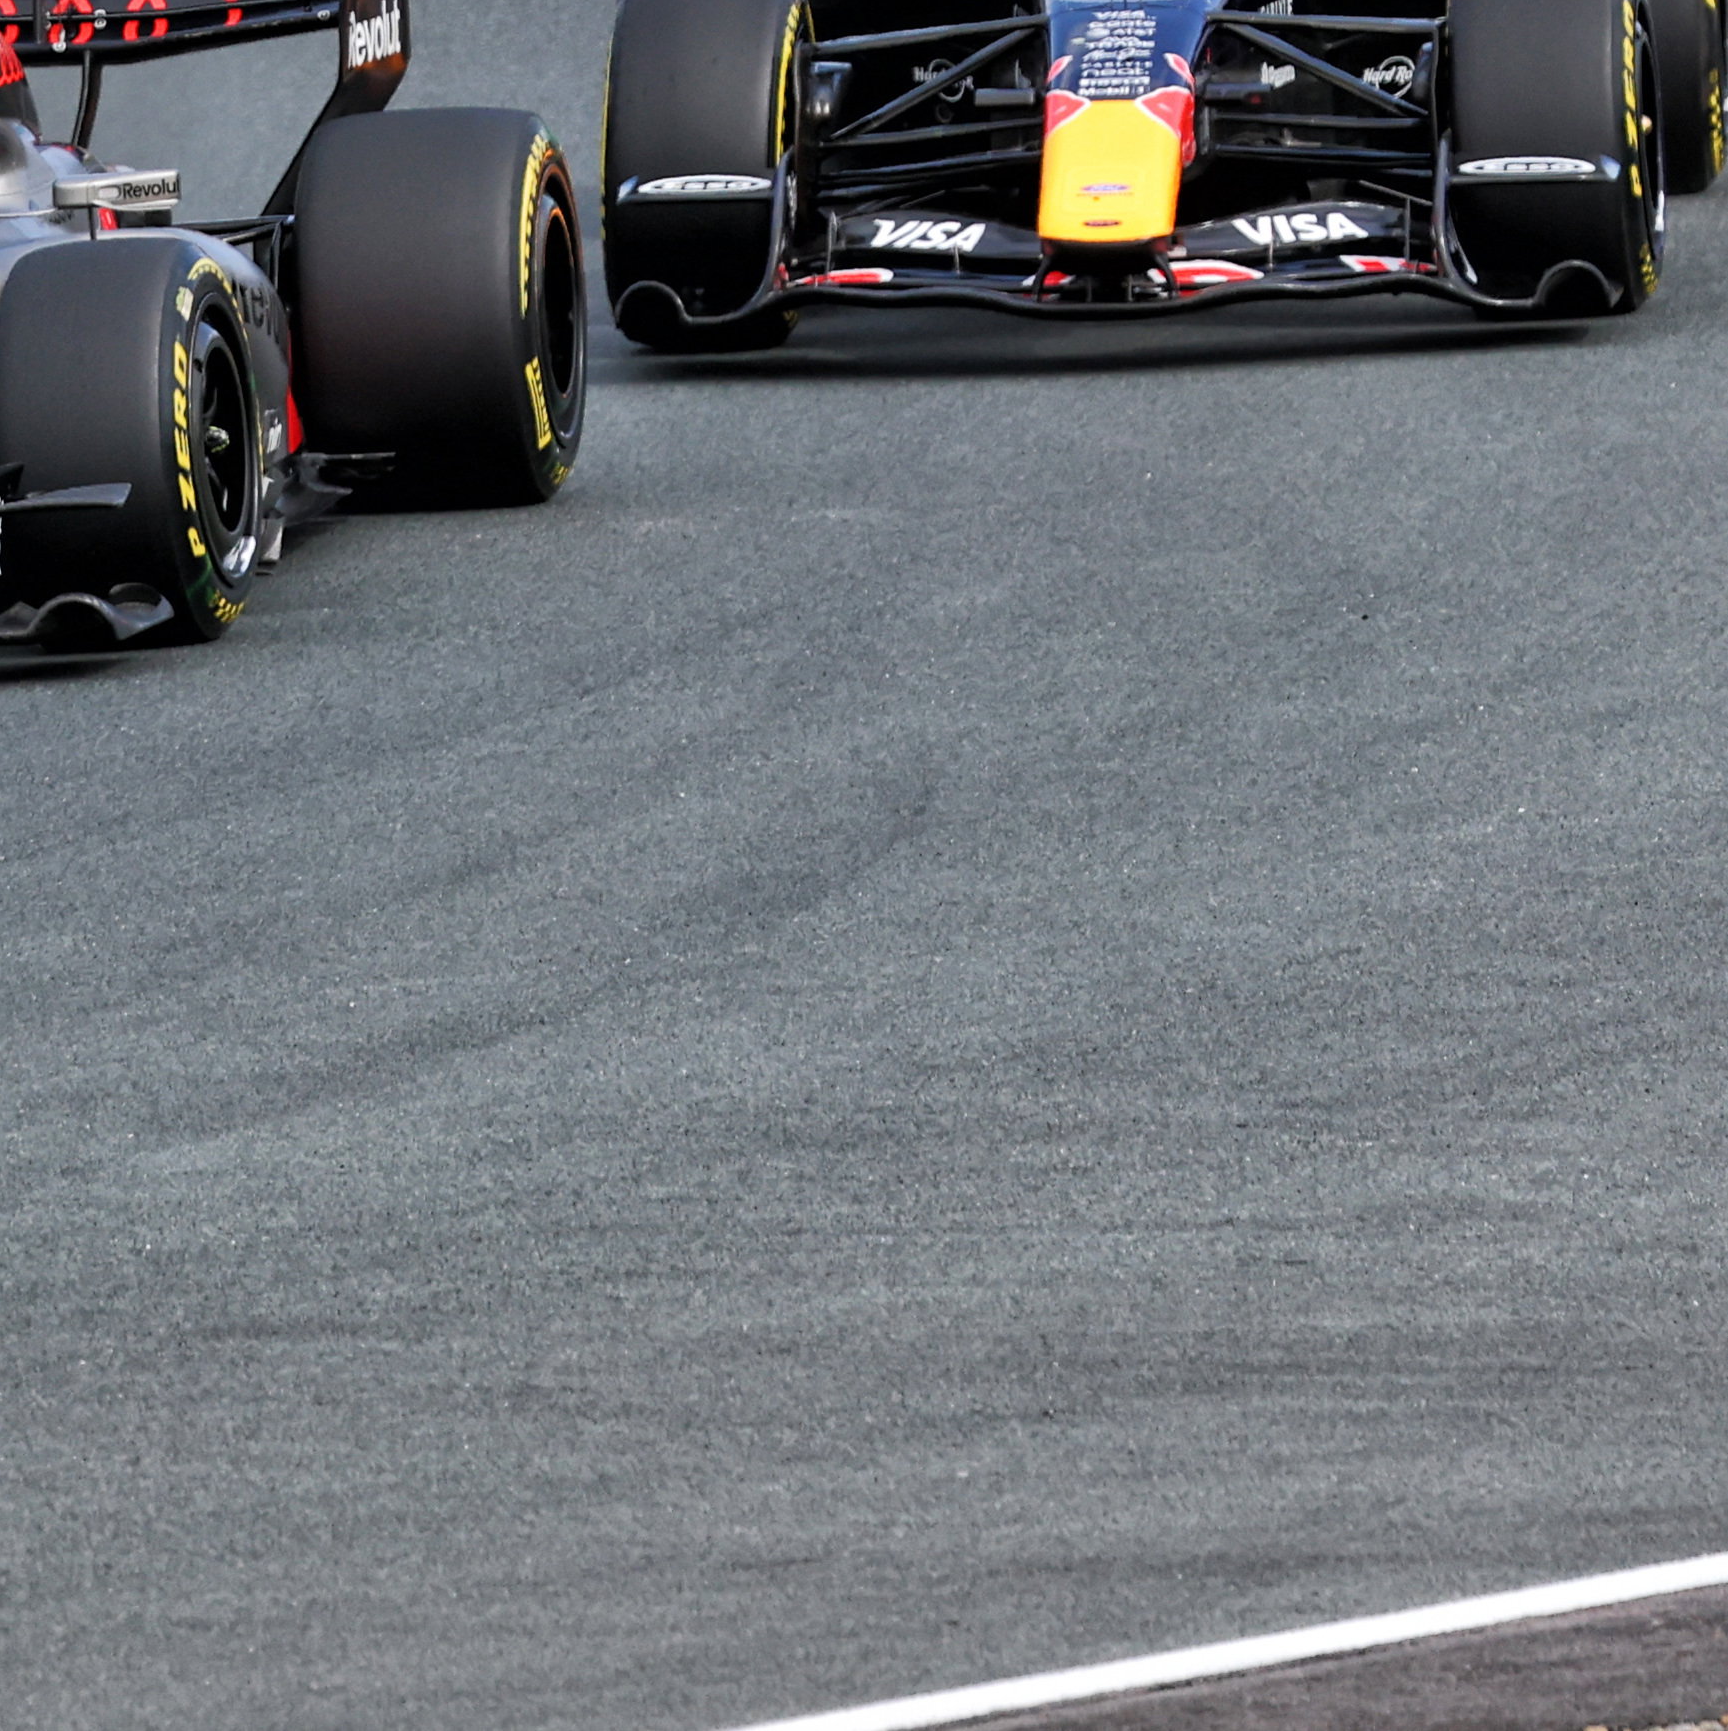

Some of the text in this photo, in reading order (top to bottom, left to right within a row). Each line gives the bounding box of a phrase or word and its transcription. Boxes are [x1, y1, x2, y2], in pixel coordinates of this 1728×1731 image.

[870, 217, 986, 253] VISA
[1231, 211, 1368, 246] VISA
[172, 340, 205, 558] P ZERO
